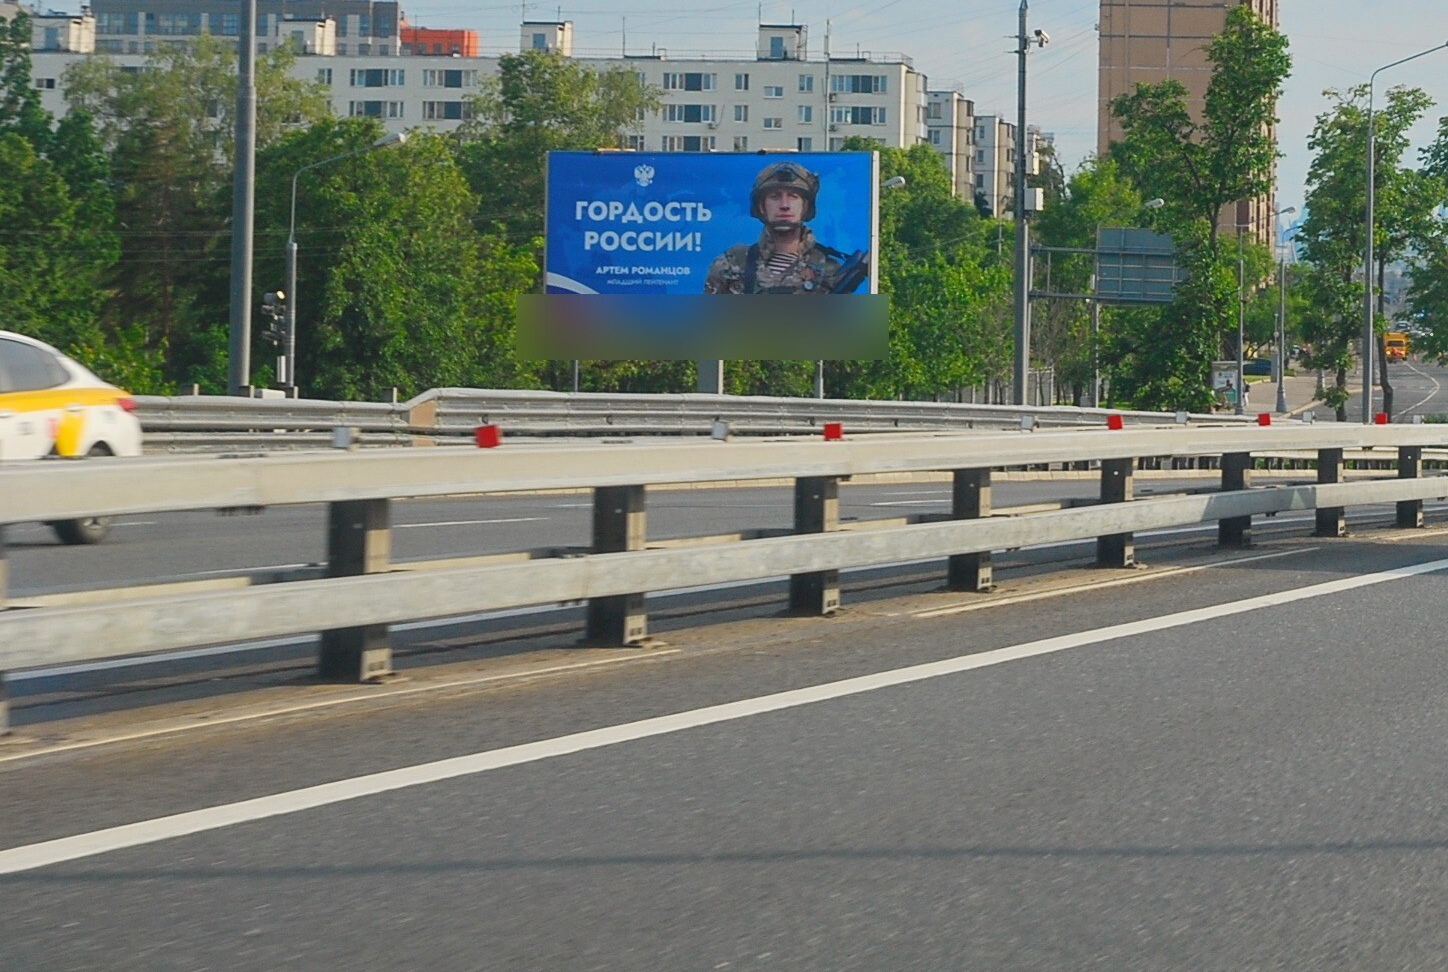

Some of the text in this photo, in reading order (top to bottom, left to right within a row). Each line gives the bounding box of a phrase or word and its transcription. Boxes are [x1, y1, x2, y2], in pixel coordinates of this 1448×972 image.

[575, 201, 712, 223] ГОРДОСТЬ
[584, 231, 701, 252] РОССИИ!
[596, 266, 690, 276] АРТЕМ РОМАНЦОВ
